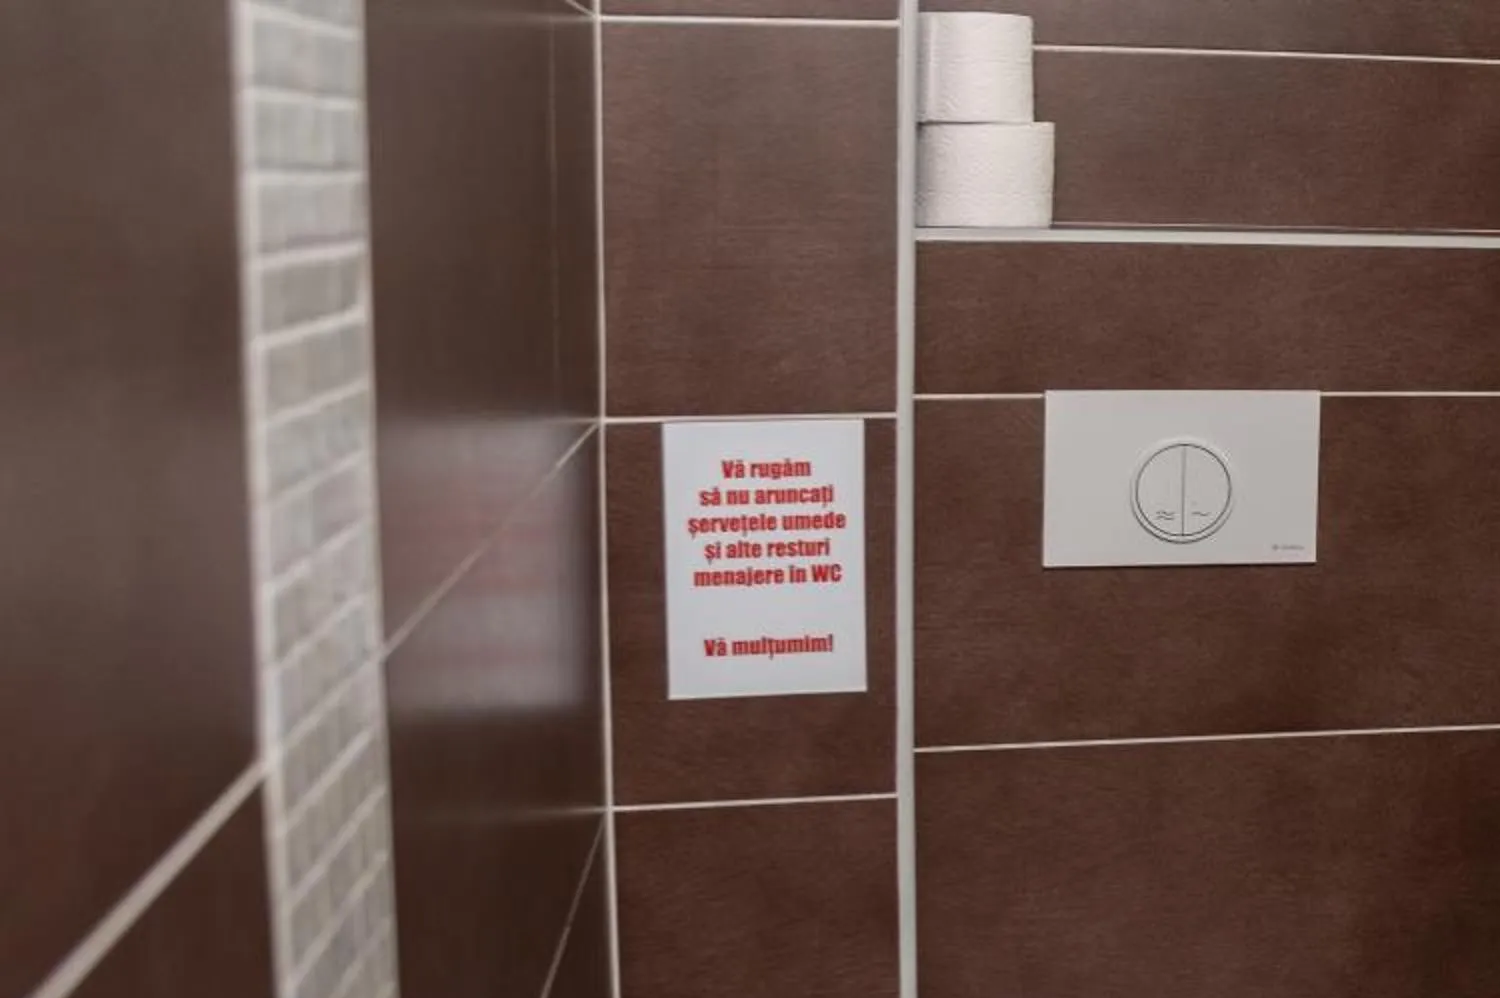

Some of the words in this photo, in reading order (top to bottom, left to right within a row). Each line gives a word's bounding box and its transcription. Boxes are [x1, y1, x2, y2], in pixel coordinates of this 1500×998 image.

[750, 458, 812, 480] rugăm
[699, 487, 721, 506] să
[726, 489, 749, 505] nu
[755, 484, 834, 508] aruncați
[687, 513, 777, 539] șervețele
[781, 511, 846, 531] umede
[704, 541, 721, 565] și
[726, 540, 762, 559] alte
[767, 537, 830, 558] resturi
[693, 566, 785, 587] menajere
[811, 563, 842, 583] WC
